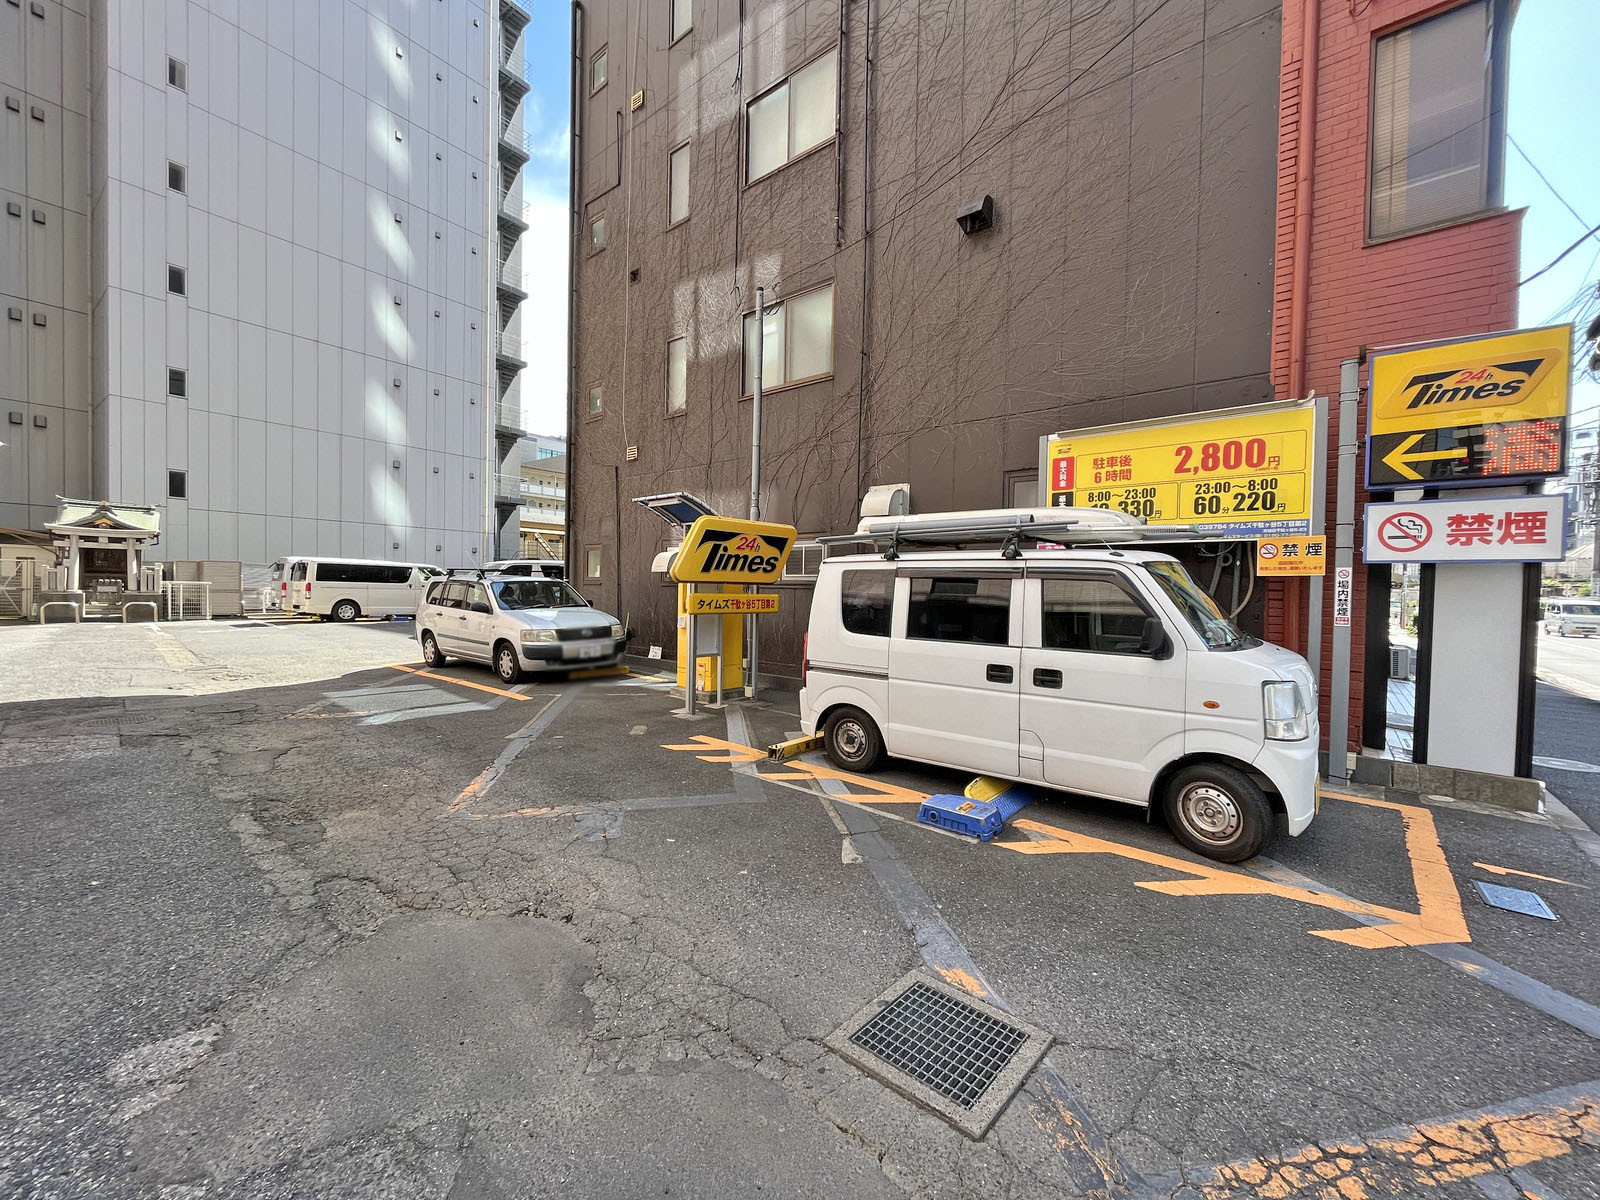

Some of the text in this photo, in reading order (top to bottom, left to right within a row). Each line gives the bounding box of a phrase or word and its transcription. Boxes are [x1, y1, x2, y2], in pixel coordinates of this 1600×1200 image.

[1455, 368, 1493, 385] 24h
[1405, 377, 1526, 410] Times
[1092, 454, 1133, 470] 駐車後
[1482, 420, 1561, 476] 満
[1058, 460, 1068, 488] 最大料金
[1446, 510, 1549, 547] 禁煙
[700, 542, 780, 574] Times
[735, 536, 761, 553] 24h
[1282, 542, 1323, 557] 禁煙
[1336, 580, 1350, 616] 場内禁煙
